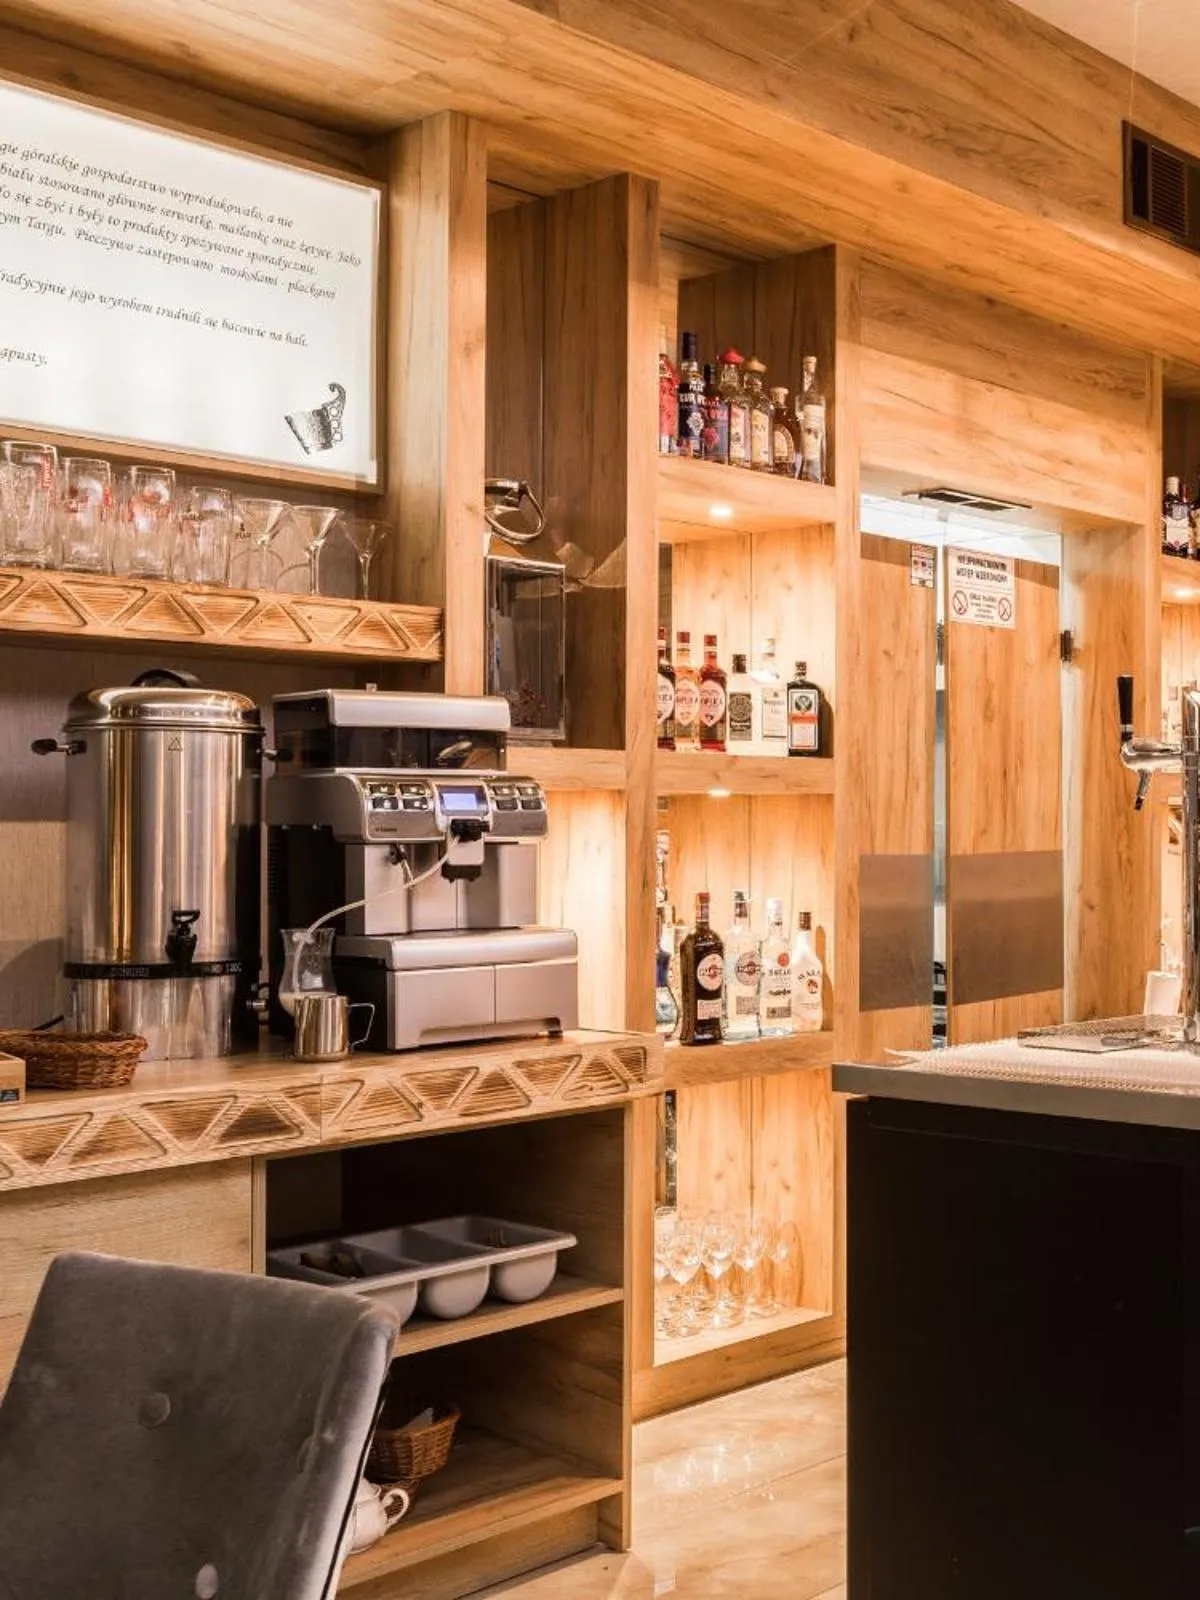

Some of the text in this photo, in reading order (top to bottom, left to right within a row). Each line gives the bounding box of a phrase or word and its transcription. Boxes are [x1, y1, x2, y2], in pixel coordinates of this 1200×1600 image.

[14, 193, 31, 206] się
[36, 196, 65, 214] zbyć
[78, 204, 104, 224] były
[108, 215, 120, 226] to
[123, 219, 178, 243] produkty
[39, 176, 105, 199] stosowano
[107, 193, 157, 213] głównie
[272, 236, 296, 249] oraz
[81, 165, 166, 193] gospodarstwo
[266, 214, 274, 223] a
[278, 217, 294, 228] nie
[25, 216, 66, 236] Targu.
[75, 228, 133, 250] Pieczywo
[136, 245, 213, 270] zastępowano
[0, 269, 66, 294] radycyjnie
[68, 289, 95, 304] jego
[99, 294, 152, 314] wyrobem
[156, 304, 200, 324] trudnili
[203, 316, 218, 331] się
[222, 319, 266, 338] bacowie
[269, 331, 282, 342] na
